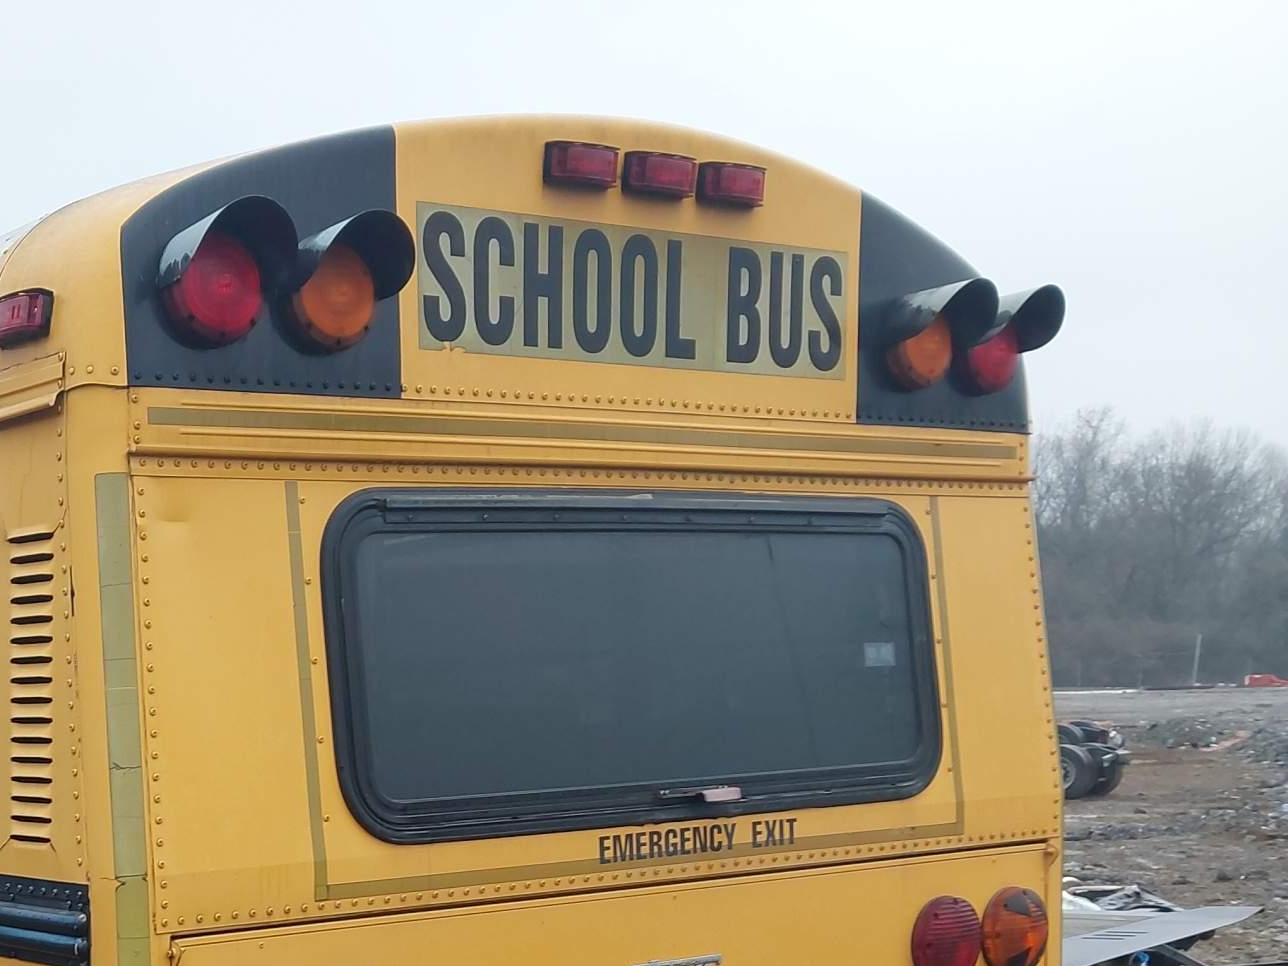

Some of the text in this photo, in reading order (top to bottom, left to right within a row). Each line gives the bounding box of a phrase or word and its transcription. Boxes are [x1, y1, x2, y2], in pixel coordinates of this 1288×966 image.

[423, 211, 843, 372] SCHOOL BUS
[598, 818, 797, 864] EMERGENCY EXIT
